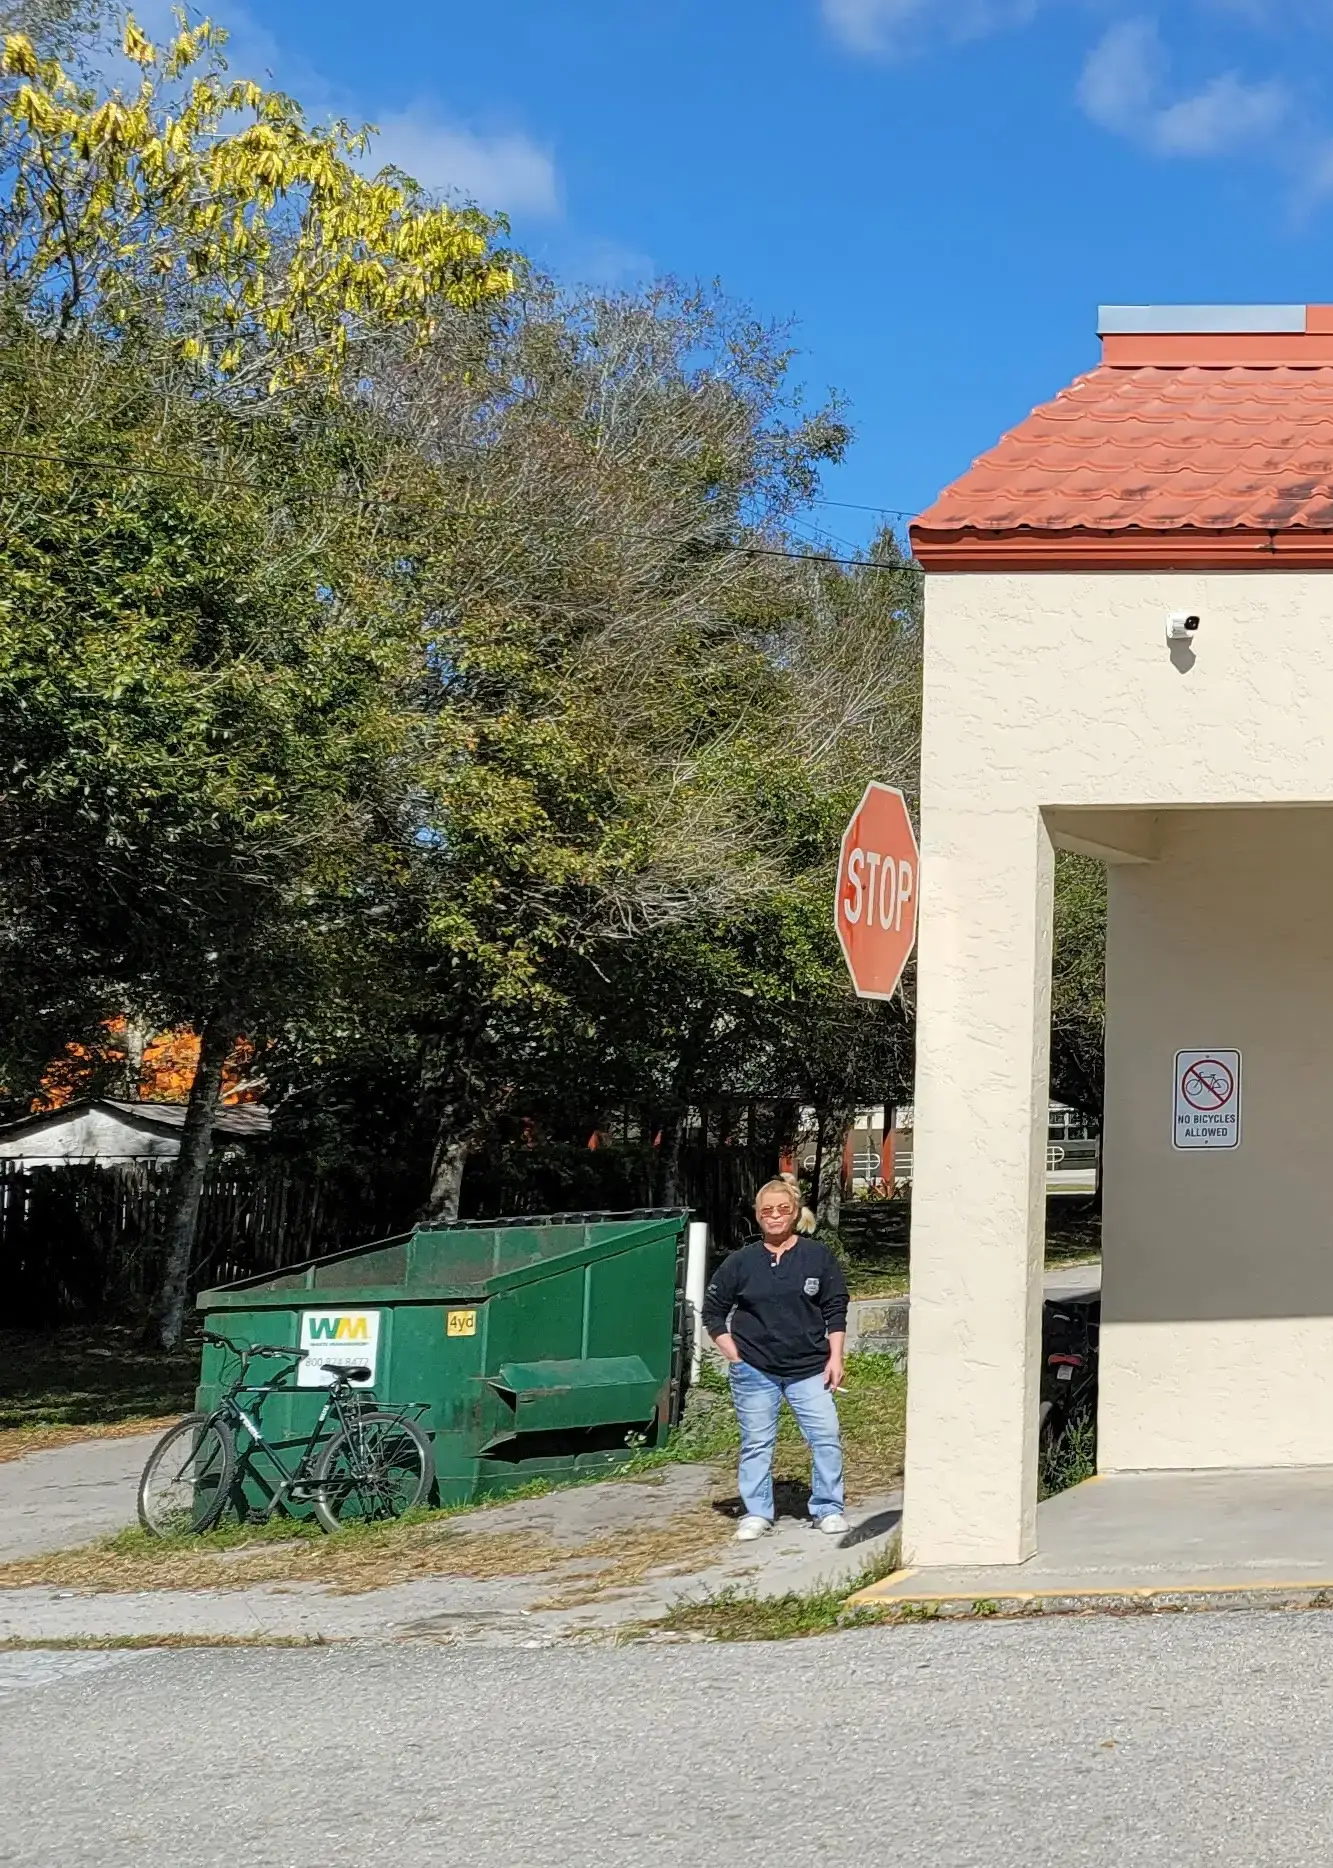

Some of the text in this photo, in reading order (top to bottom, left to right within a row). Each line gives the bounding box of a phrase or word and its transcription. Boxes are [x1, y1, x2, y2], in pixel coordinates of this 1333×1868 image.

[844, 847, 912, 932] STOP
[1177, 1114, 1236, 1124] NO BICYCLES
[1184, 1127, 1228, 1137] ALLOWED
[308, 1317, 369, 1340] WM
[449, 1314, 474, 1332] 4yd
